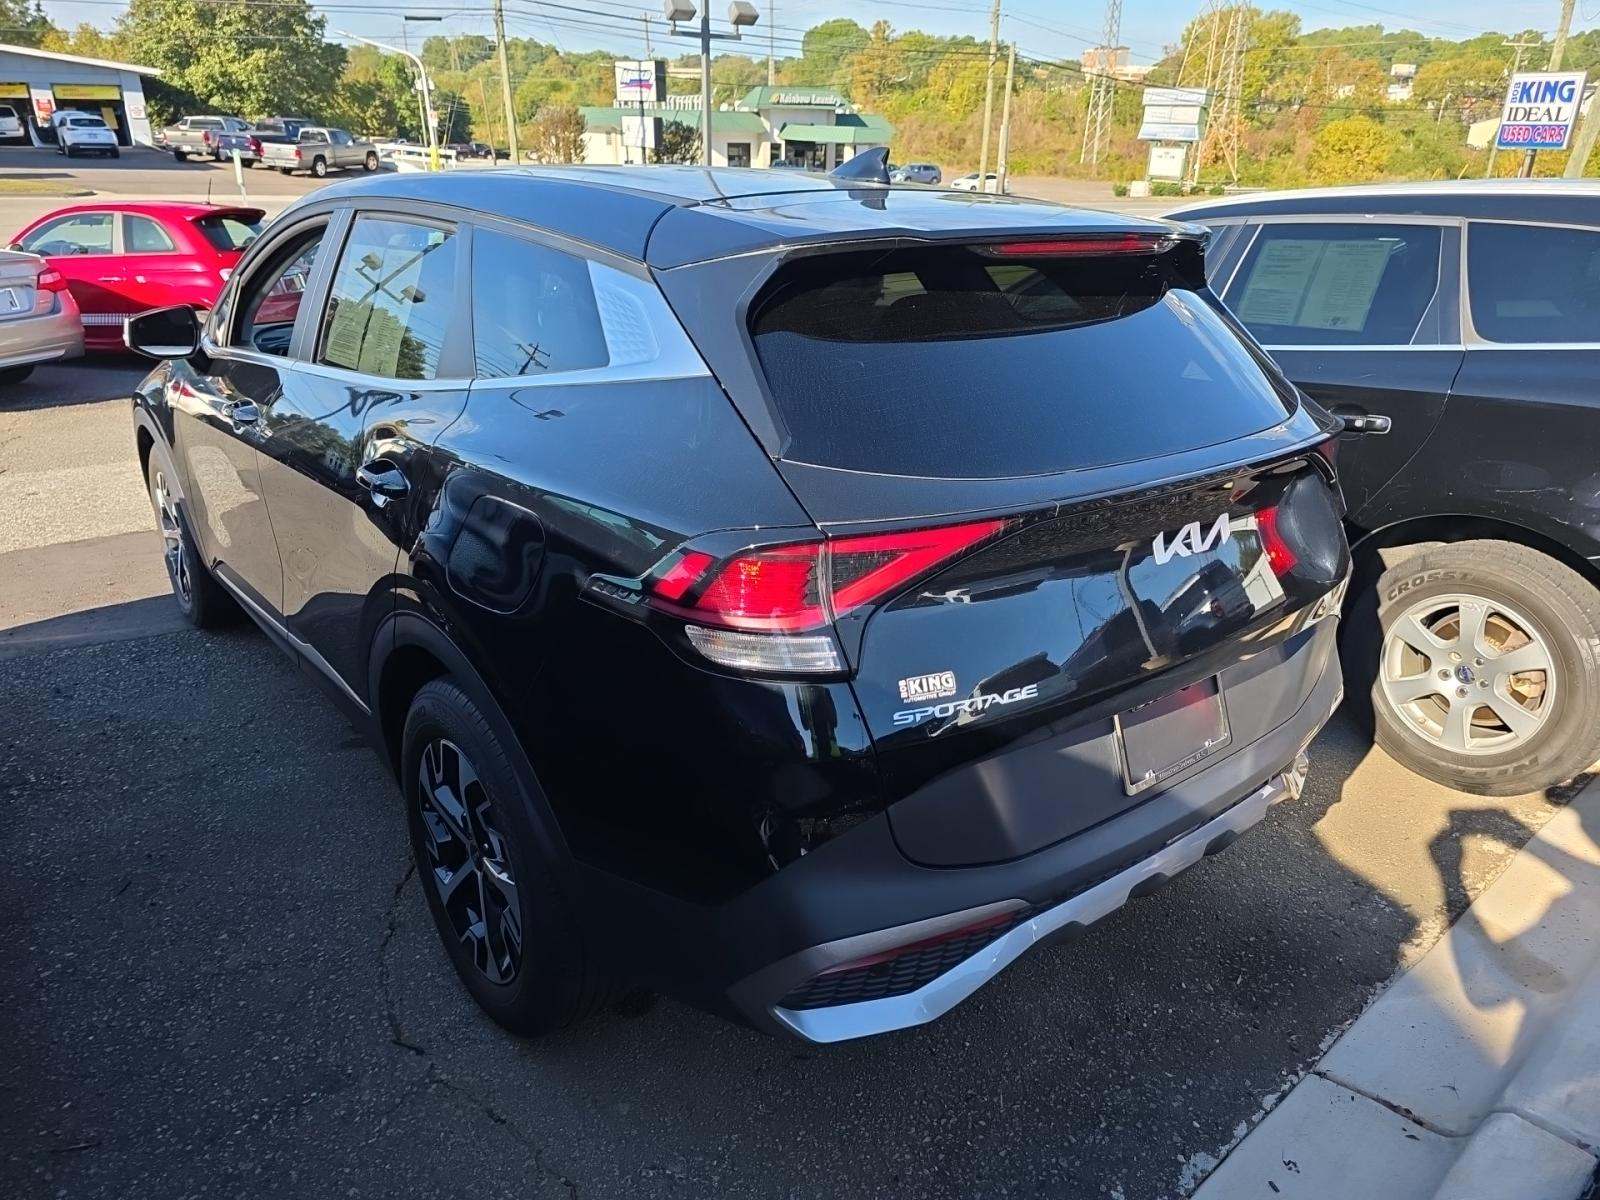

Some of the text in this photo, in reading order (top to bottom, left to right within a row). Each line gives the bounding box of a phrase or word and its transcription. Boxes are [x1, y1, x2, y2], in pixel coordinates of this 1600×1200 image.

[1511, 82, 1521, 103] BOB
[1518, 80, 1575, 103] KING
[1507, 106, 1568, 122] IDEAL
[1501, 126, 1566, 143] USED CARS
[898, 680, 908, 699] BOB
[908, 672, 954, 695] KING
[893, 683, 1039, 726] SPORTAGE
